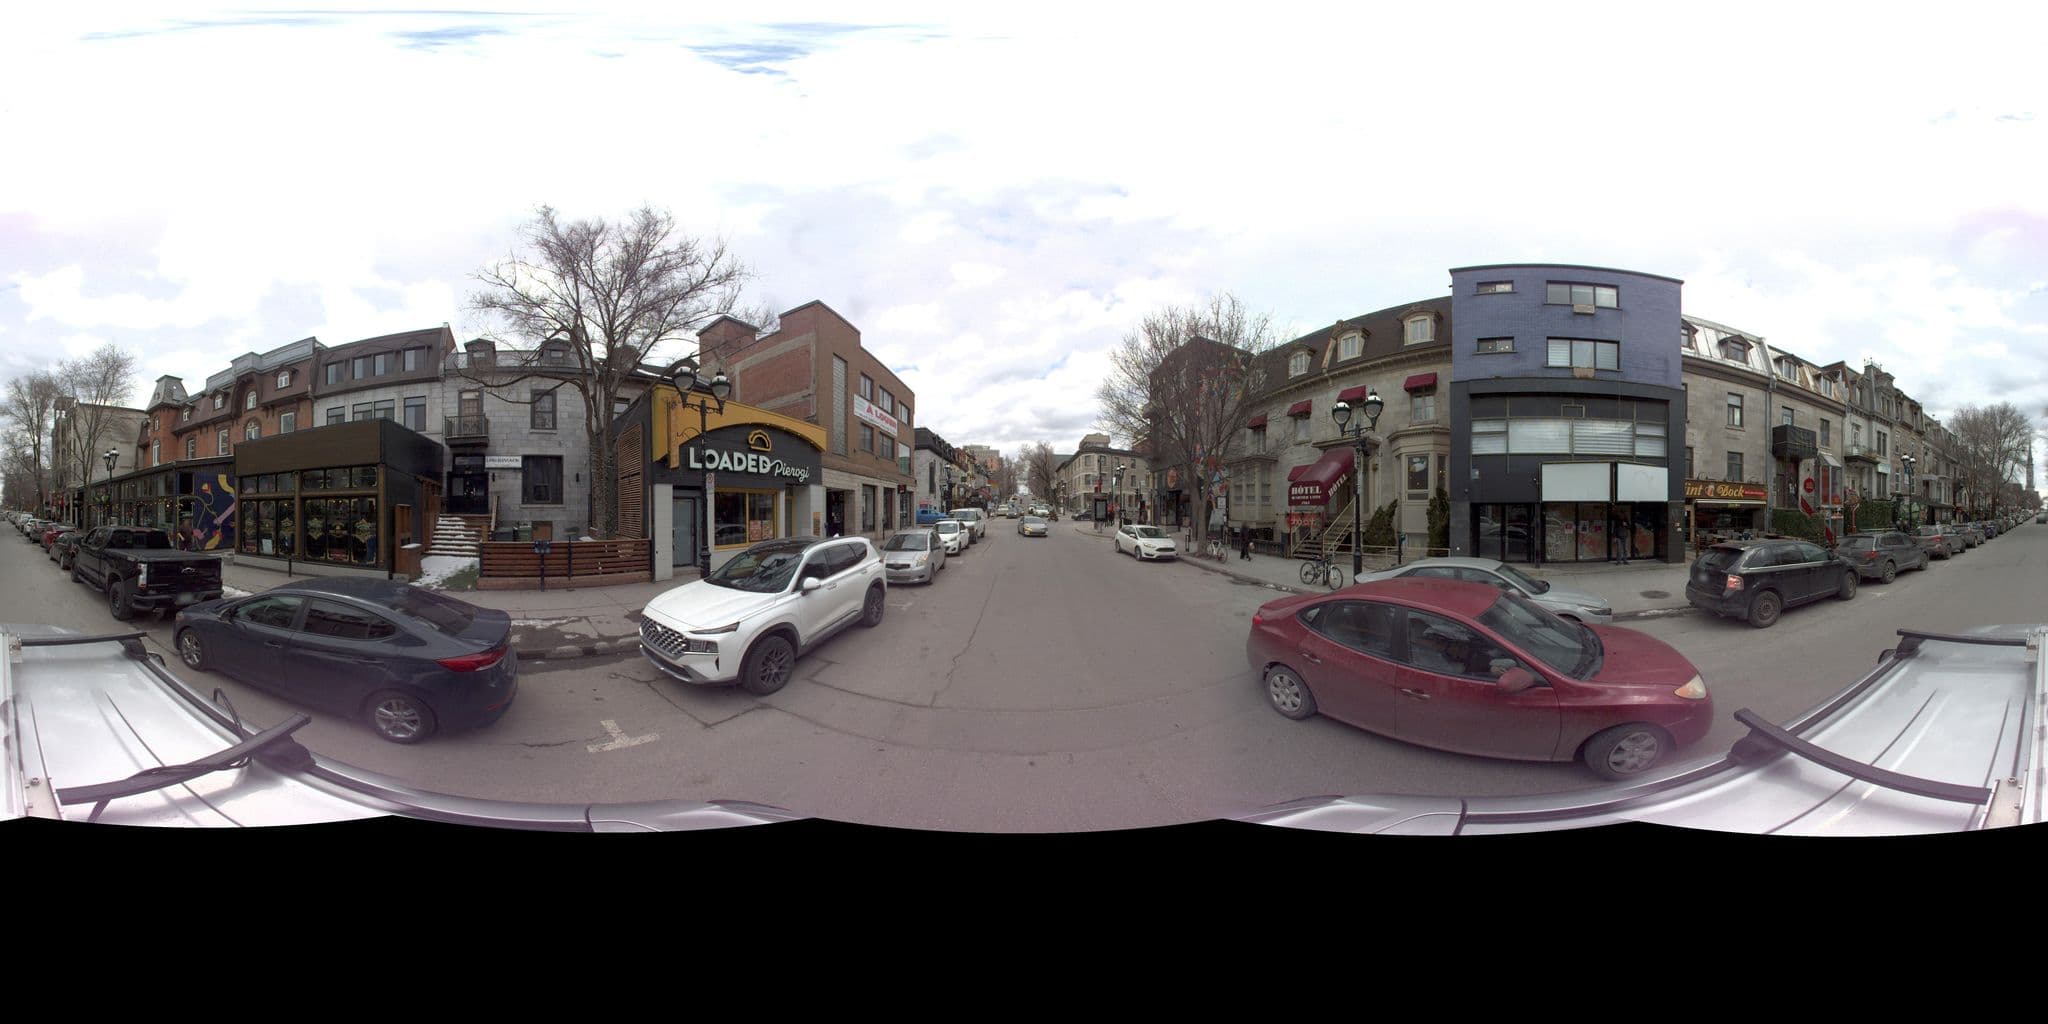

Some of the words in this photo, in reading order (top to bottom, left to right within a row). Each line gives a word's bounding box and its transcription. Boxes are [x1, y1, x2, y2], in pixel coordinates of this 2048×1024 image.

[689, 446, 771, 474] LOADED
[770, 459, 810, 482] Pierogi
[1291, 484, 1322, 495] HÔTEL
[1685, 482, 1704, 496] int
[1716, 484, 1745, 498] Bock
